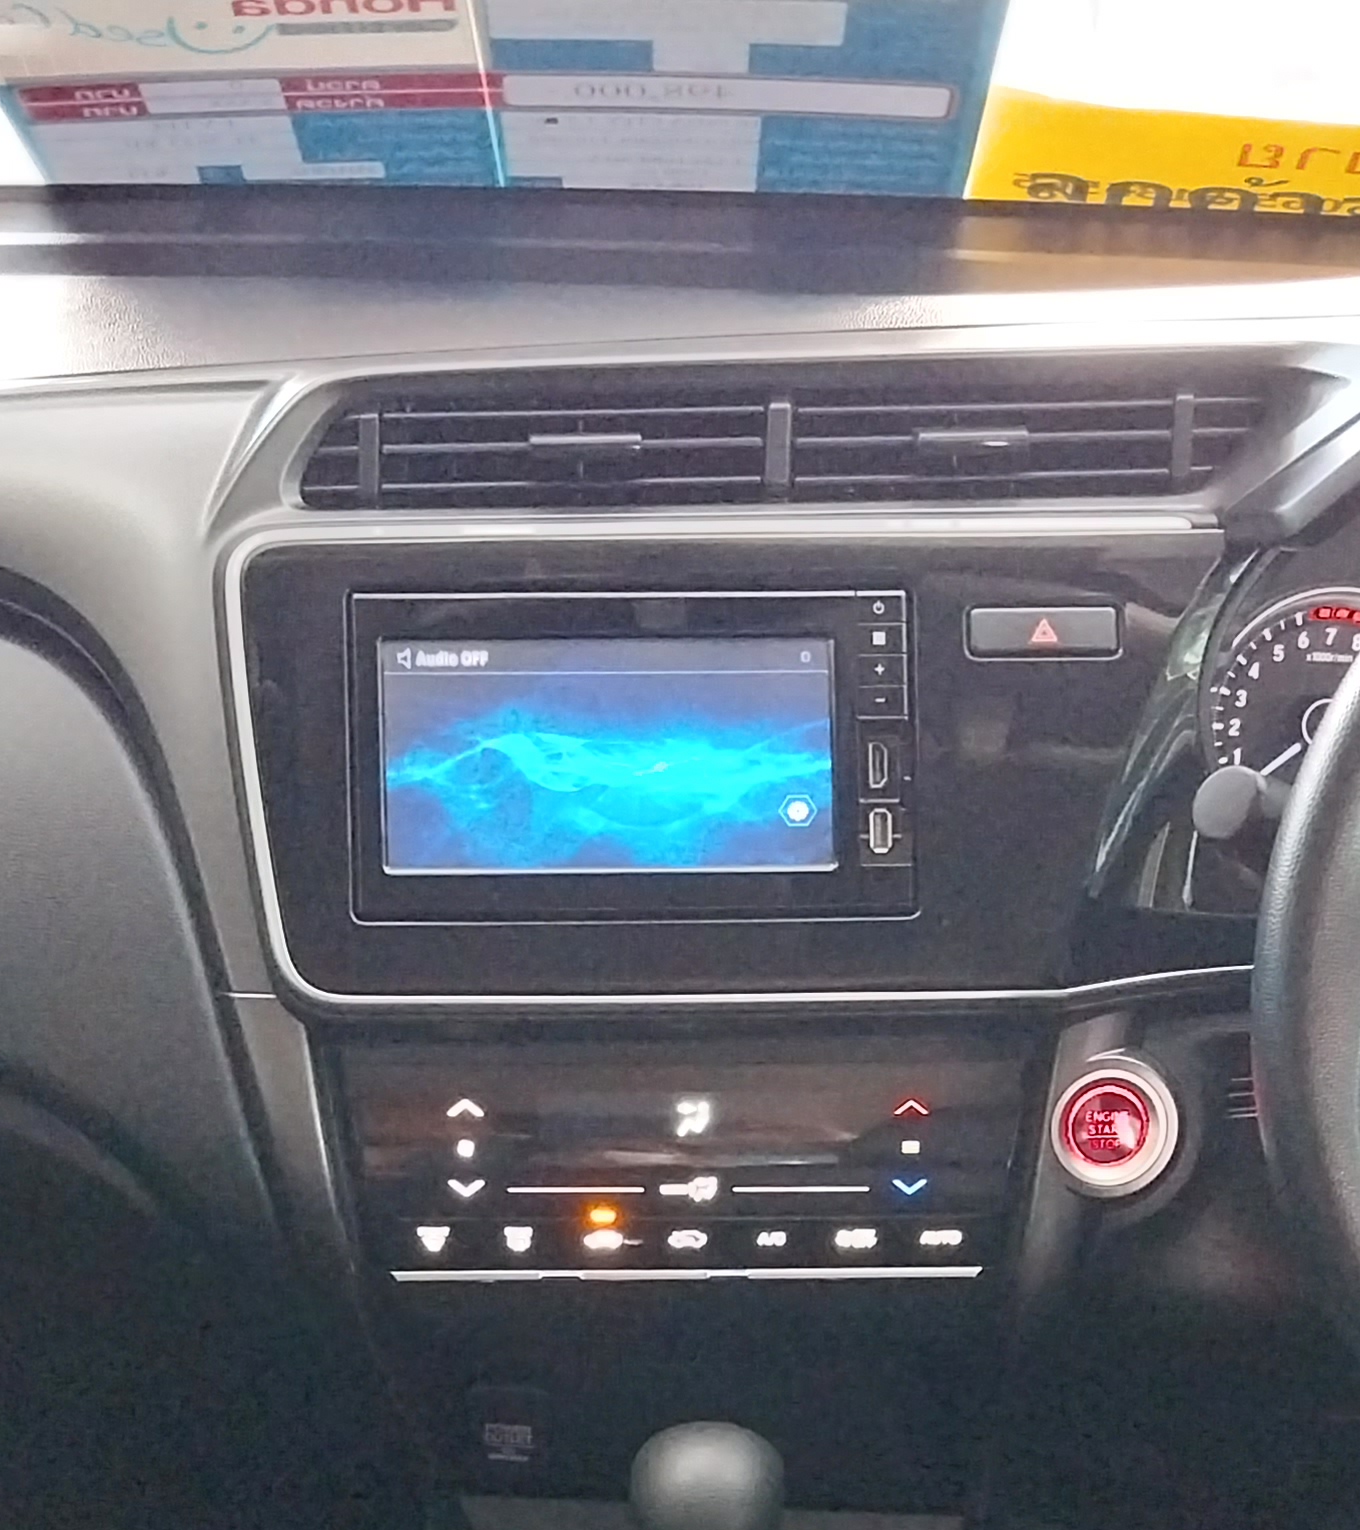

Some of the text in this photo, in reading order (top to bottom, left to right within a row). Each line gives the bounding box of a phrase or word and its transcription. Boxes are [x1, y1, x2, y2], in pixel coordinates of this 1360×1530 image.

[1297, 631, 1310, 649] 6
[1325, 627, 1338, 646] 7
[415, 650, 489, 667] Audio OFF
[1272, 644, 1285, 662] 5
[1248, 661, 1260, 680] 4
[1235, 690, 1247, 708] 3
[1228, 718, 1241, 736] 2
[1233, 747, 1242, 766] 1
